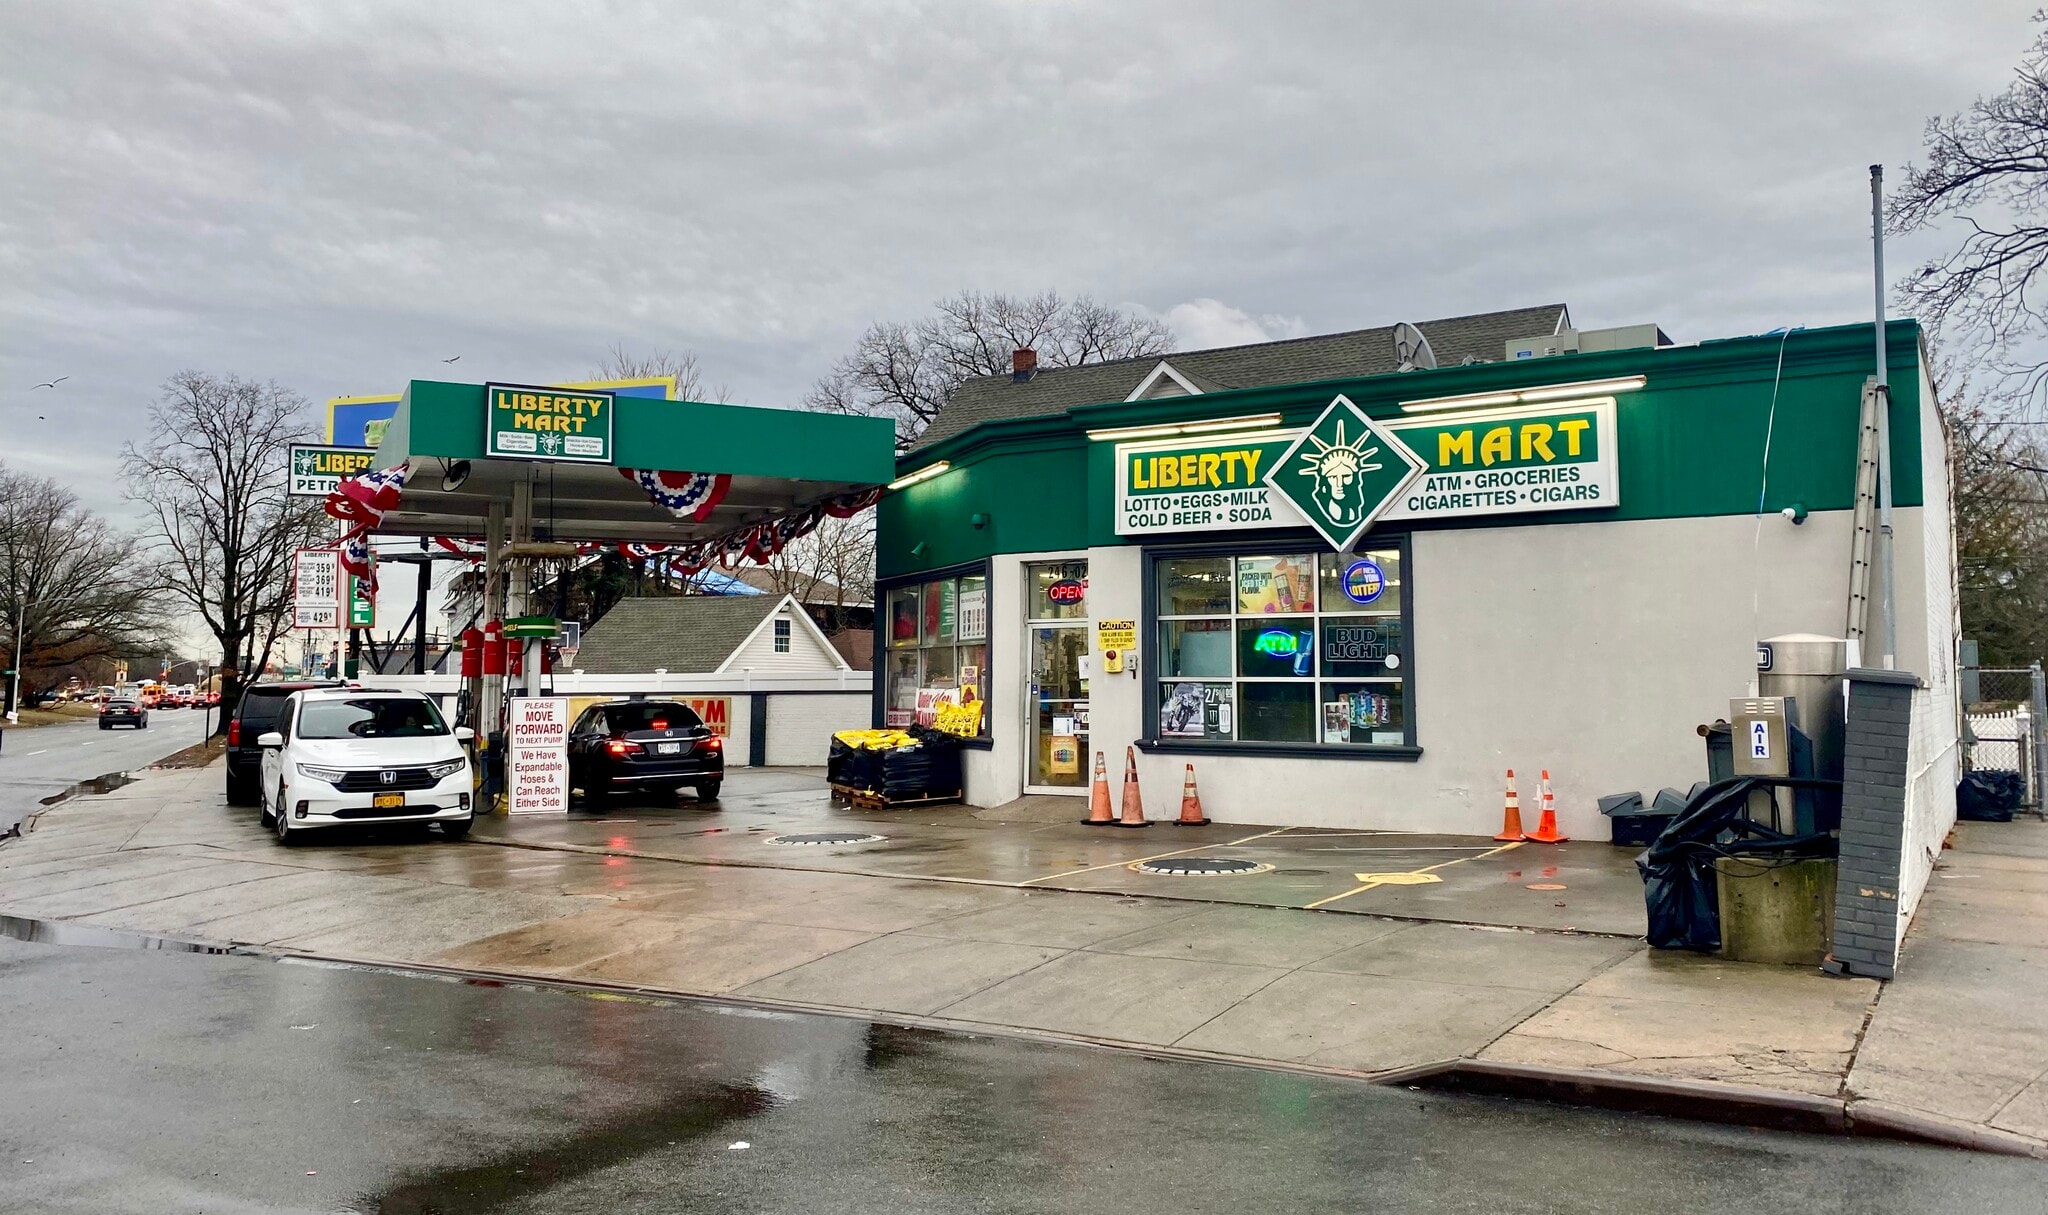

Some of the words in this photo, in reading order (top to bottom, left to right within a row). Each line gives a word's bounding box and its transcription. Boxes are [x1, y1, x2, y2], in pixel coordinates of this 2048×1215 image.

[498, 392, 602, 417] LIBERTY
[514, 412, 586, 434] MART
[1438, 420, 1590, 466] MART
[316, 454, 374, 472] LIBER
[1134, 450, 1262, 489] LIBERTY
[1426, 476, 1461, 492] ATM
[1474, 466, 1580, 488] GROCERIES
[297, 480, 340, 492] PETR
[1124, 496, 1170, 512] LOTTO
[1181, 494, 1222, 508] EGGS
[1231, 490, 1268, 506] MILK
[1408, 490, 1516, 511] CIGARETTES
[1530, 484, 1600, 502] CIGARS
[1128, 512, 1168, 528] COLD
[1172, 510, 1212, 525] BEER
[1229, 507, 1272, 522] SODA
[316, 564, 330, 573] 359
[1048, 566, 1086, 578] 246-02
[316, 575, 330, 585] 369
[315, 587, 330, 597] 419
[1050, 586, 1084, 599] OPEN
[313, 612, 328, 622] 429
[1336, 628, 1376, 643] BUD
[1254, 634, 1297, 651] ATM
[1328, 644, 1385, 658] LIGHT
[526, 711, 553, 721] MOVE
[692, 700, 726, 723] TM
[516, 724, 563, 735] FORWARD
[1754, 724, 1766, 755] AIR
[521, 750, 534, 760] We
[536, 751, 556, 759] Have
[515, 762, 562, 773] Expandable
[520, 774, 546, 783] Hoses
[548, 774, 554, 782] &
[516, 786, 532, 796] Can
[535, 786, 560, 795] Reach
[516, 798, 539, 807] Either
[542, 798, 560, 807] Side
